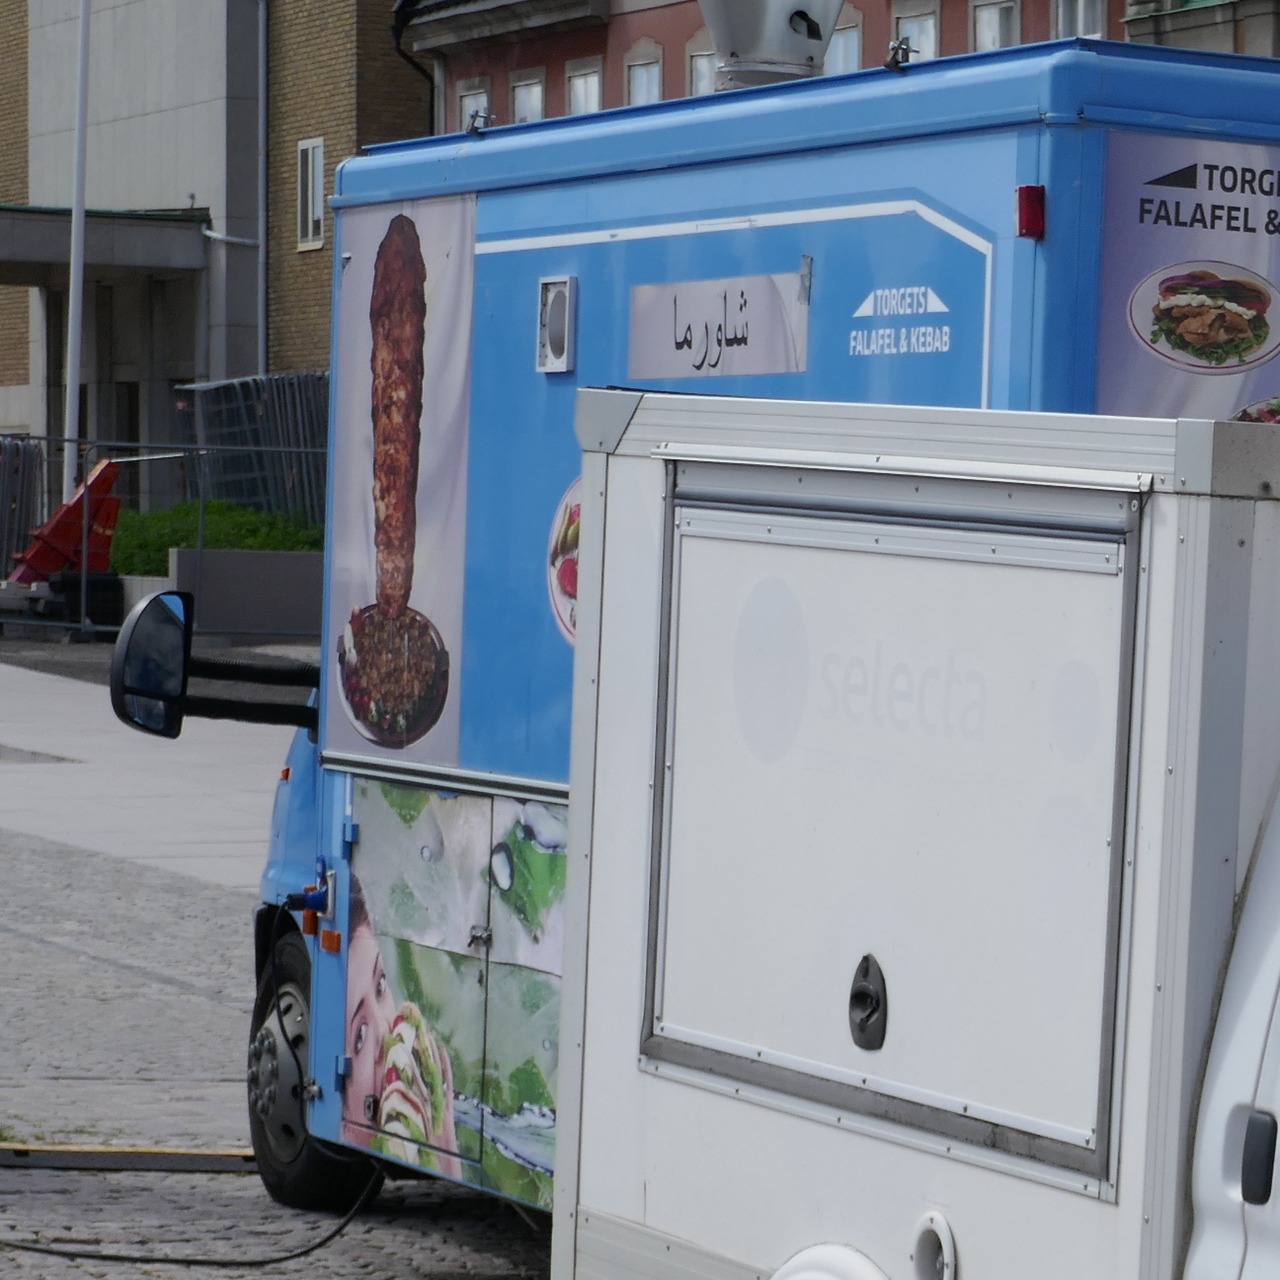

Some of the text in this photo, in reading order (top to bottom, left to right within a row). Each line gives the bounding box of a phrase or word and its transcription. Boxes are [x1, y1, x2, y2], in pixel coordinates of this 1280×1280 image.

[1139, 198, 1257, 234] FALAFEL
[876, 286, 926, 316] TORGETS
[849, 325, 951, 356] FALAFEL & KEBAB
[819, 639, 987, 743] selecta
